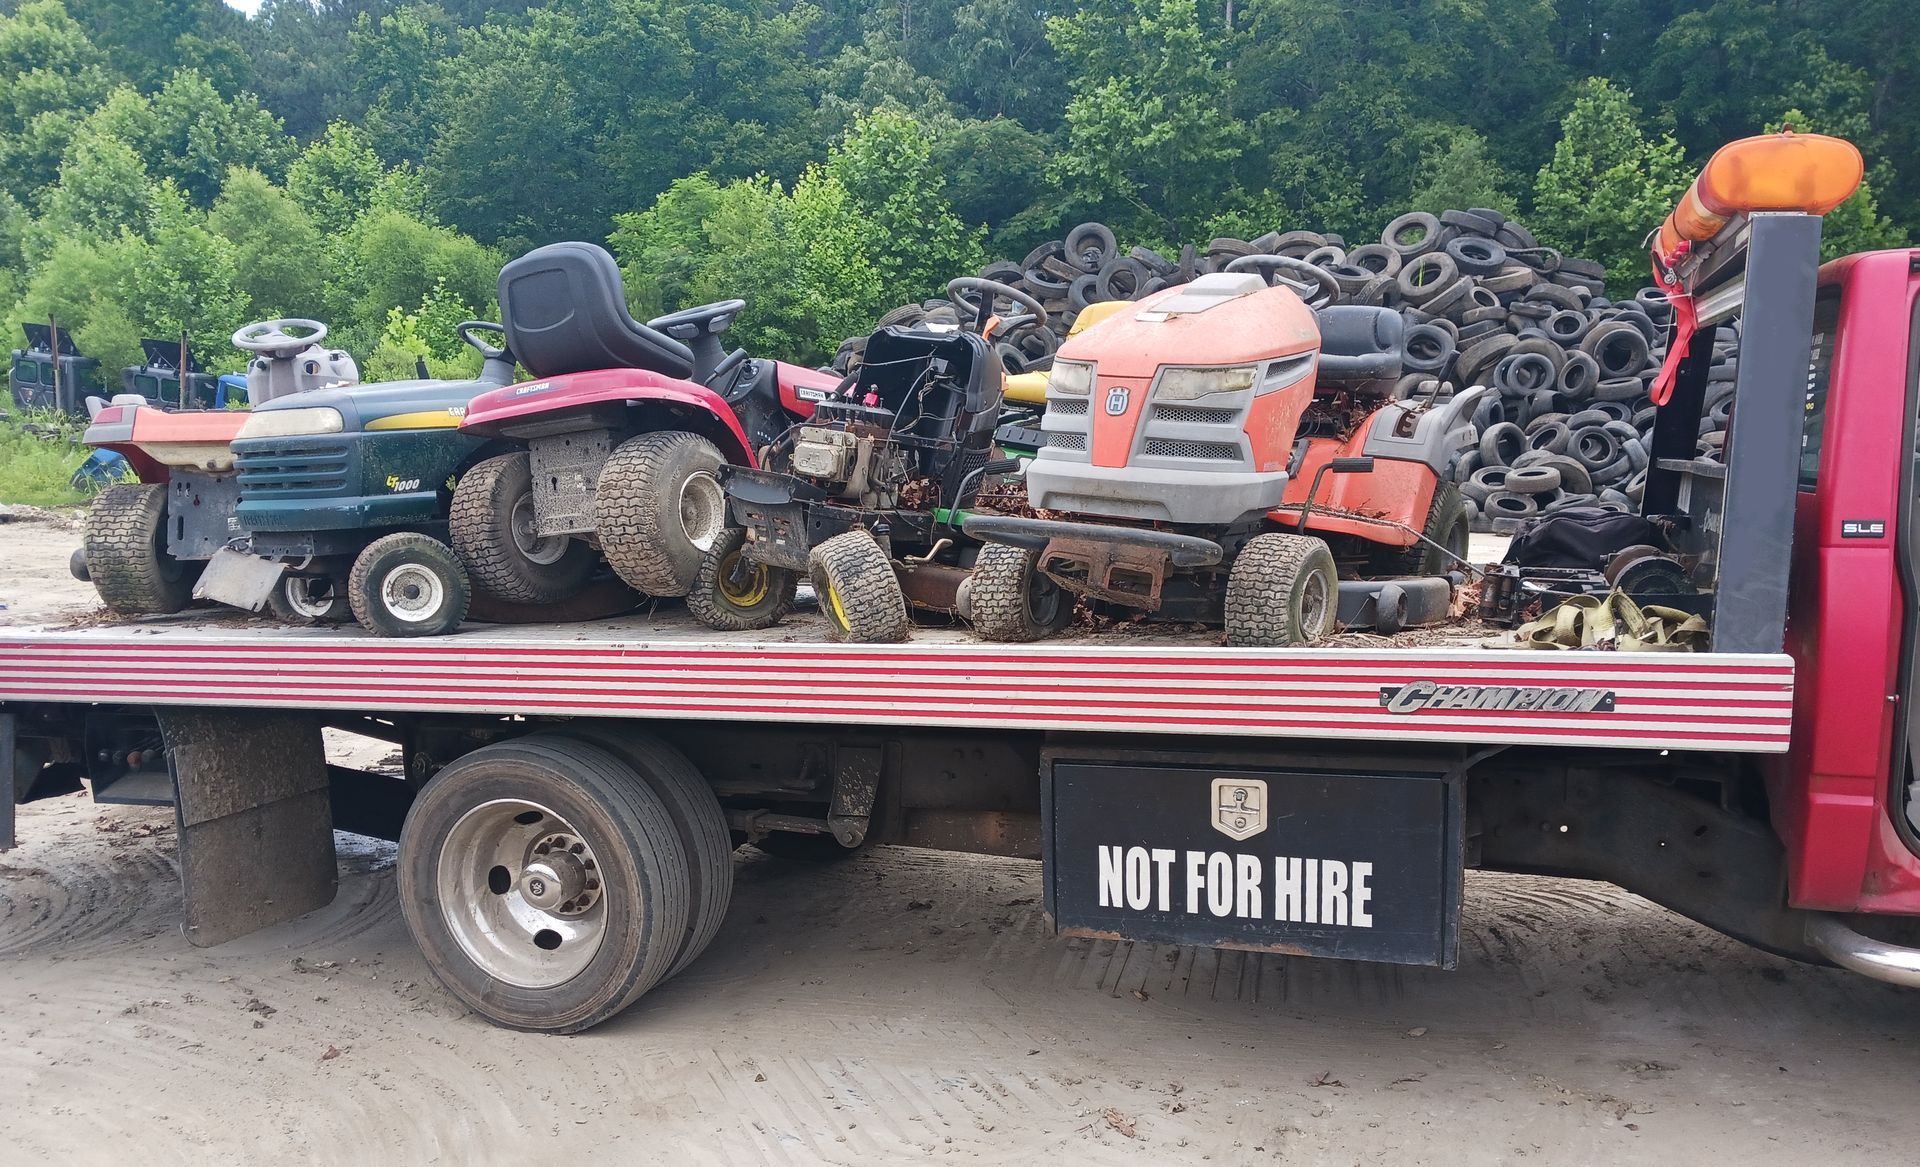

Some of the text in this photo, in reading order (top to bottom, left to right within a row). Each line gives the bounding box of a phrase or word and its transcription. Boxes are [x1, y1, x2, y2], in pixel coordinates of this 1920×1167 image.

[516, 382, 550, 395] CRAFTSMAN
[1843, 523, 1884, 533] SLE
[1098, 845, 1373, 928] NOT FOR HIRE
